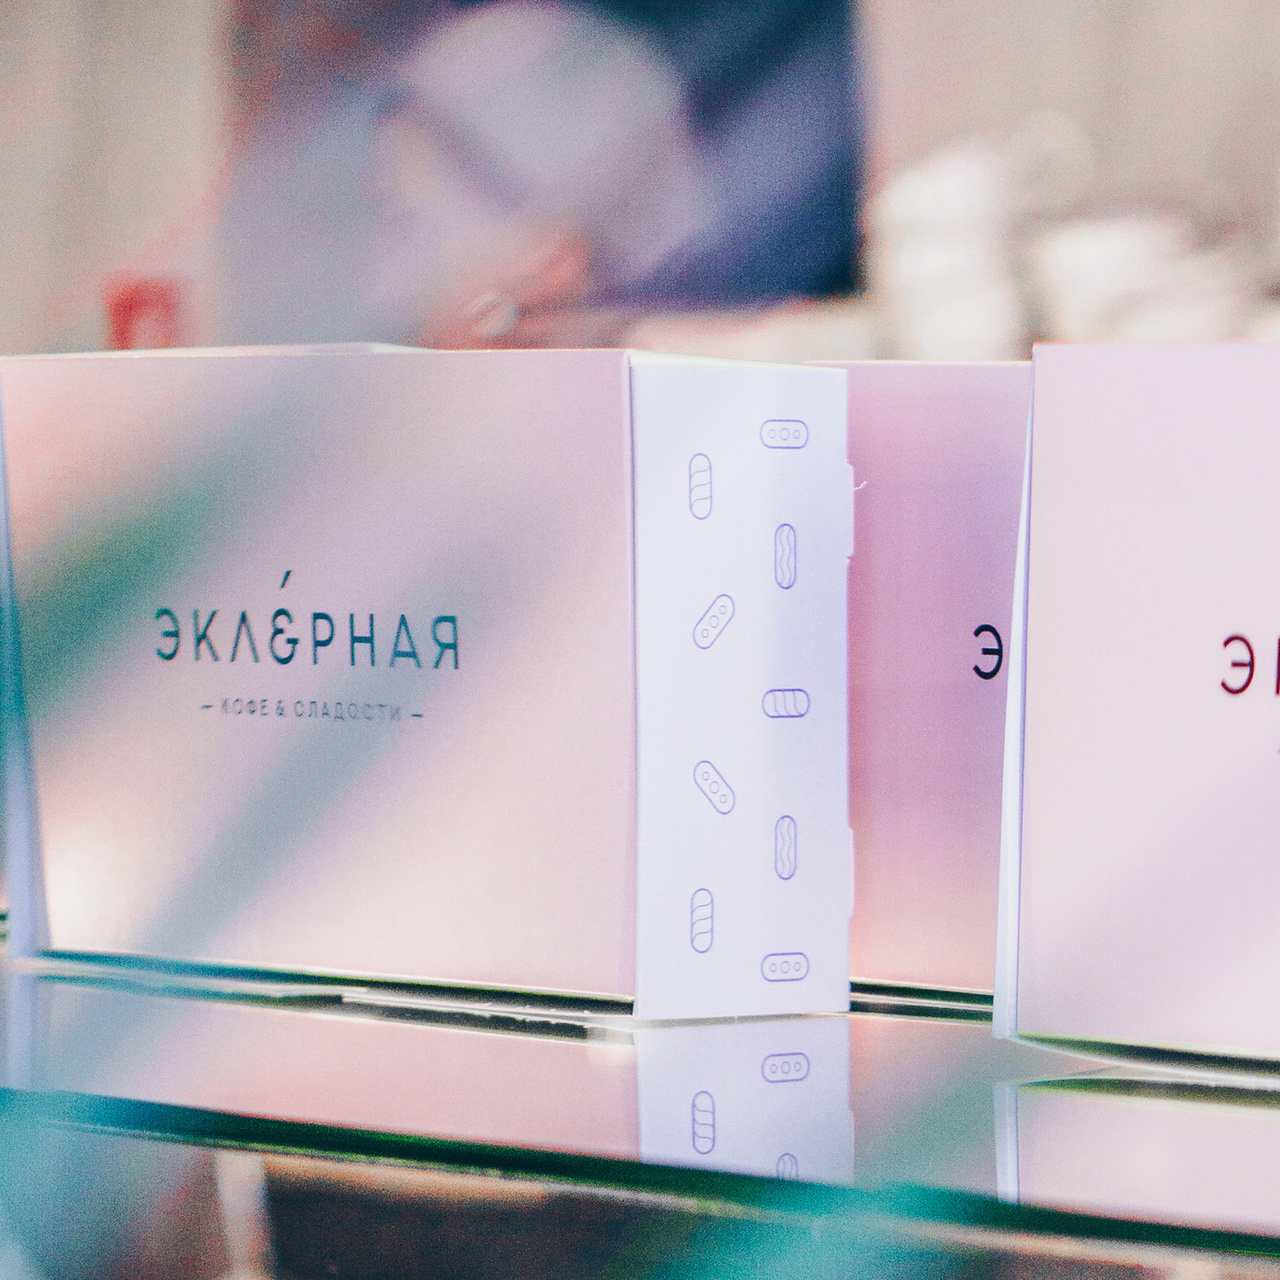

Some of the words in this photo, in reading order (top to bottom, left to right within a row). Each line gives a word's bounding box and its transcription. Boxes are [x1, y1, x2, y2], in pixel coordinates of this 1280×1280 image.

[973, 624, 1003, 680] Э
[220, 698, 268, 717] КОФЕ
[293, 700, 401, 721] СЛАДОСТИ
